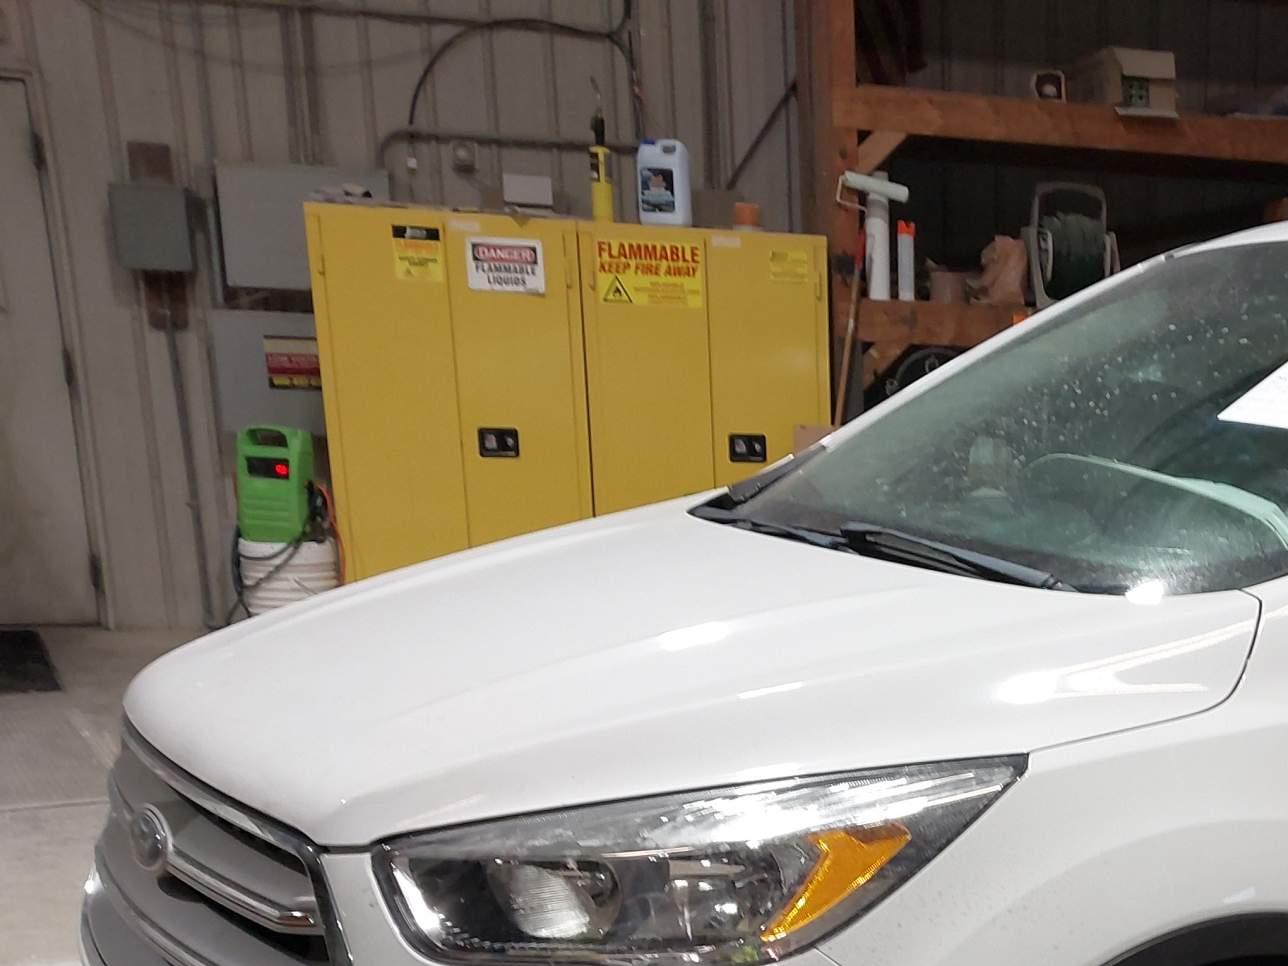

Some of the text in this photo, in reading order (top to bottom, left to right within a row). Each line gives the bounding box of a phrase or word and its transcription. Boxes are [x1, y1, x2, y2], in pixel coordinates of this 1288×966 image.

[478, 246, 533, 262] DANGER
[597, 240, 700, 264] FLAMMABLE
[475, 261, 536, 276] FLAMMABLE
[599, 260, 699, 278] KEEP FIRE AWAY
[487, 273, 527, 288] LIQUIDS
